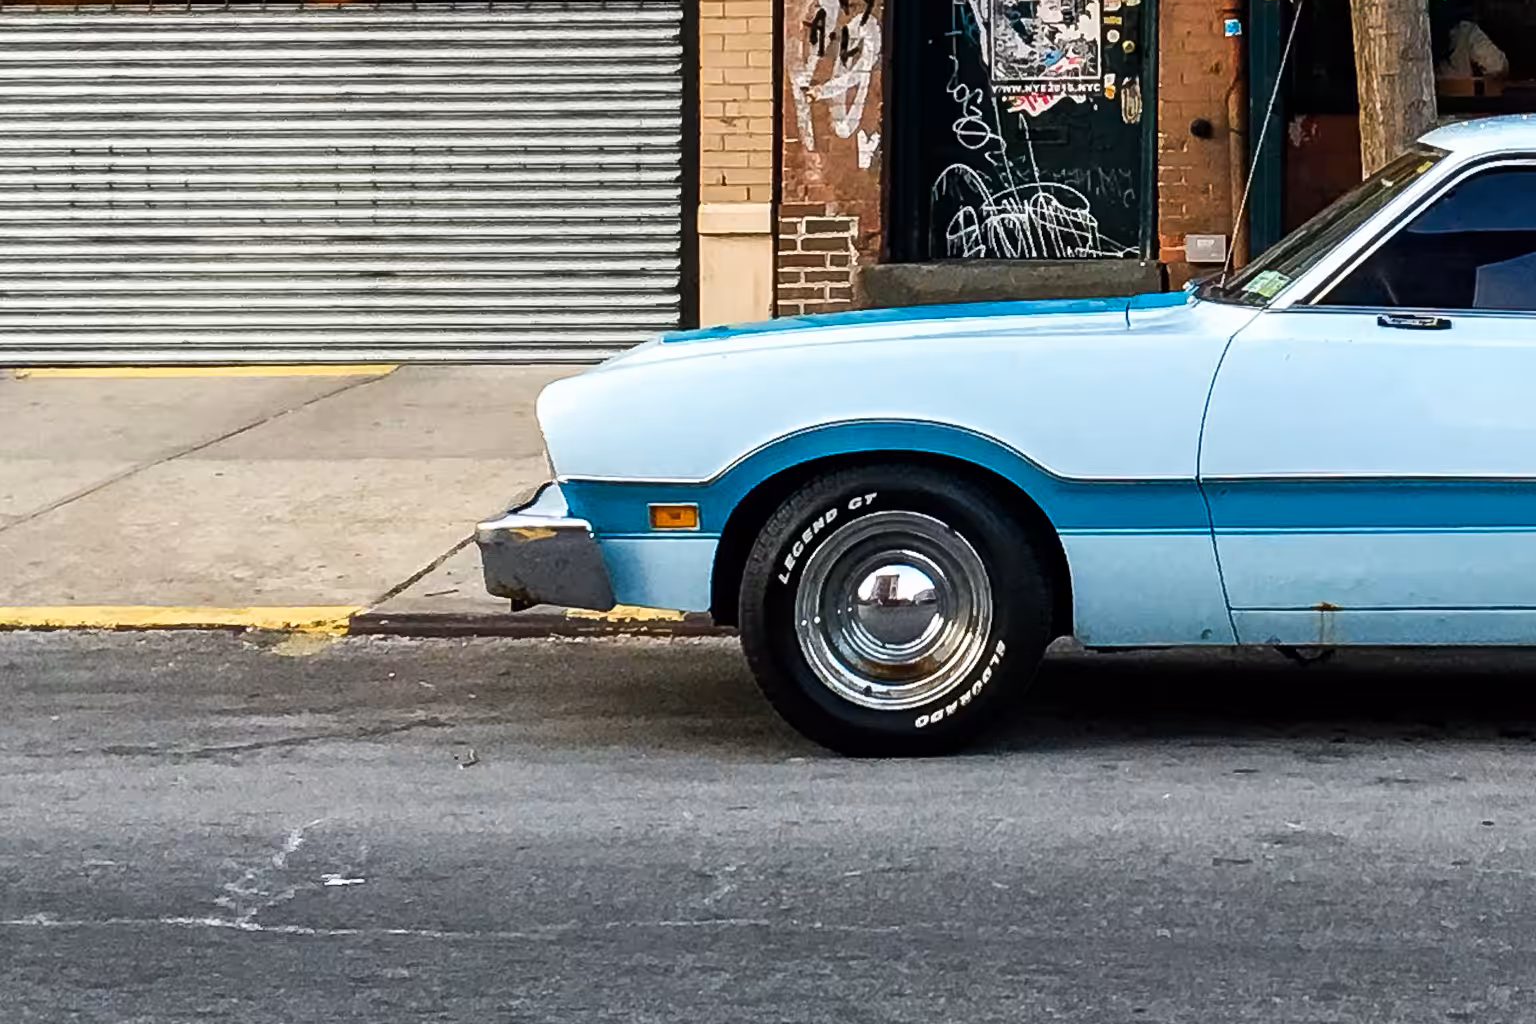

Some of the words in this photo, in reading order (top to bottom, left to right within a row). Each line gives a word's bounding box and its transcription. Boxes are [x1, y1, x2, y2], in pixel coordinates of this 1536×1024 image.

[778, 508, 838, 585] LEGEND
[848, 492, 878, 510] GT
[914, 639, 1007, 728] ELDORADO
